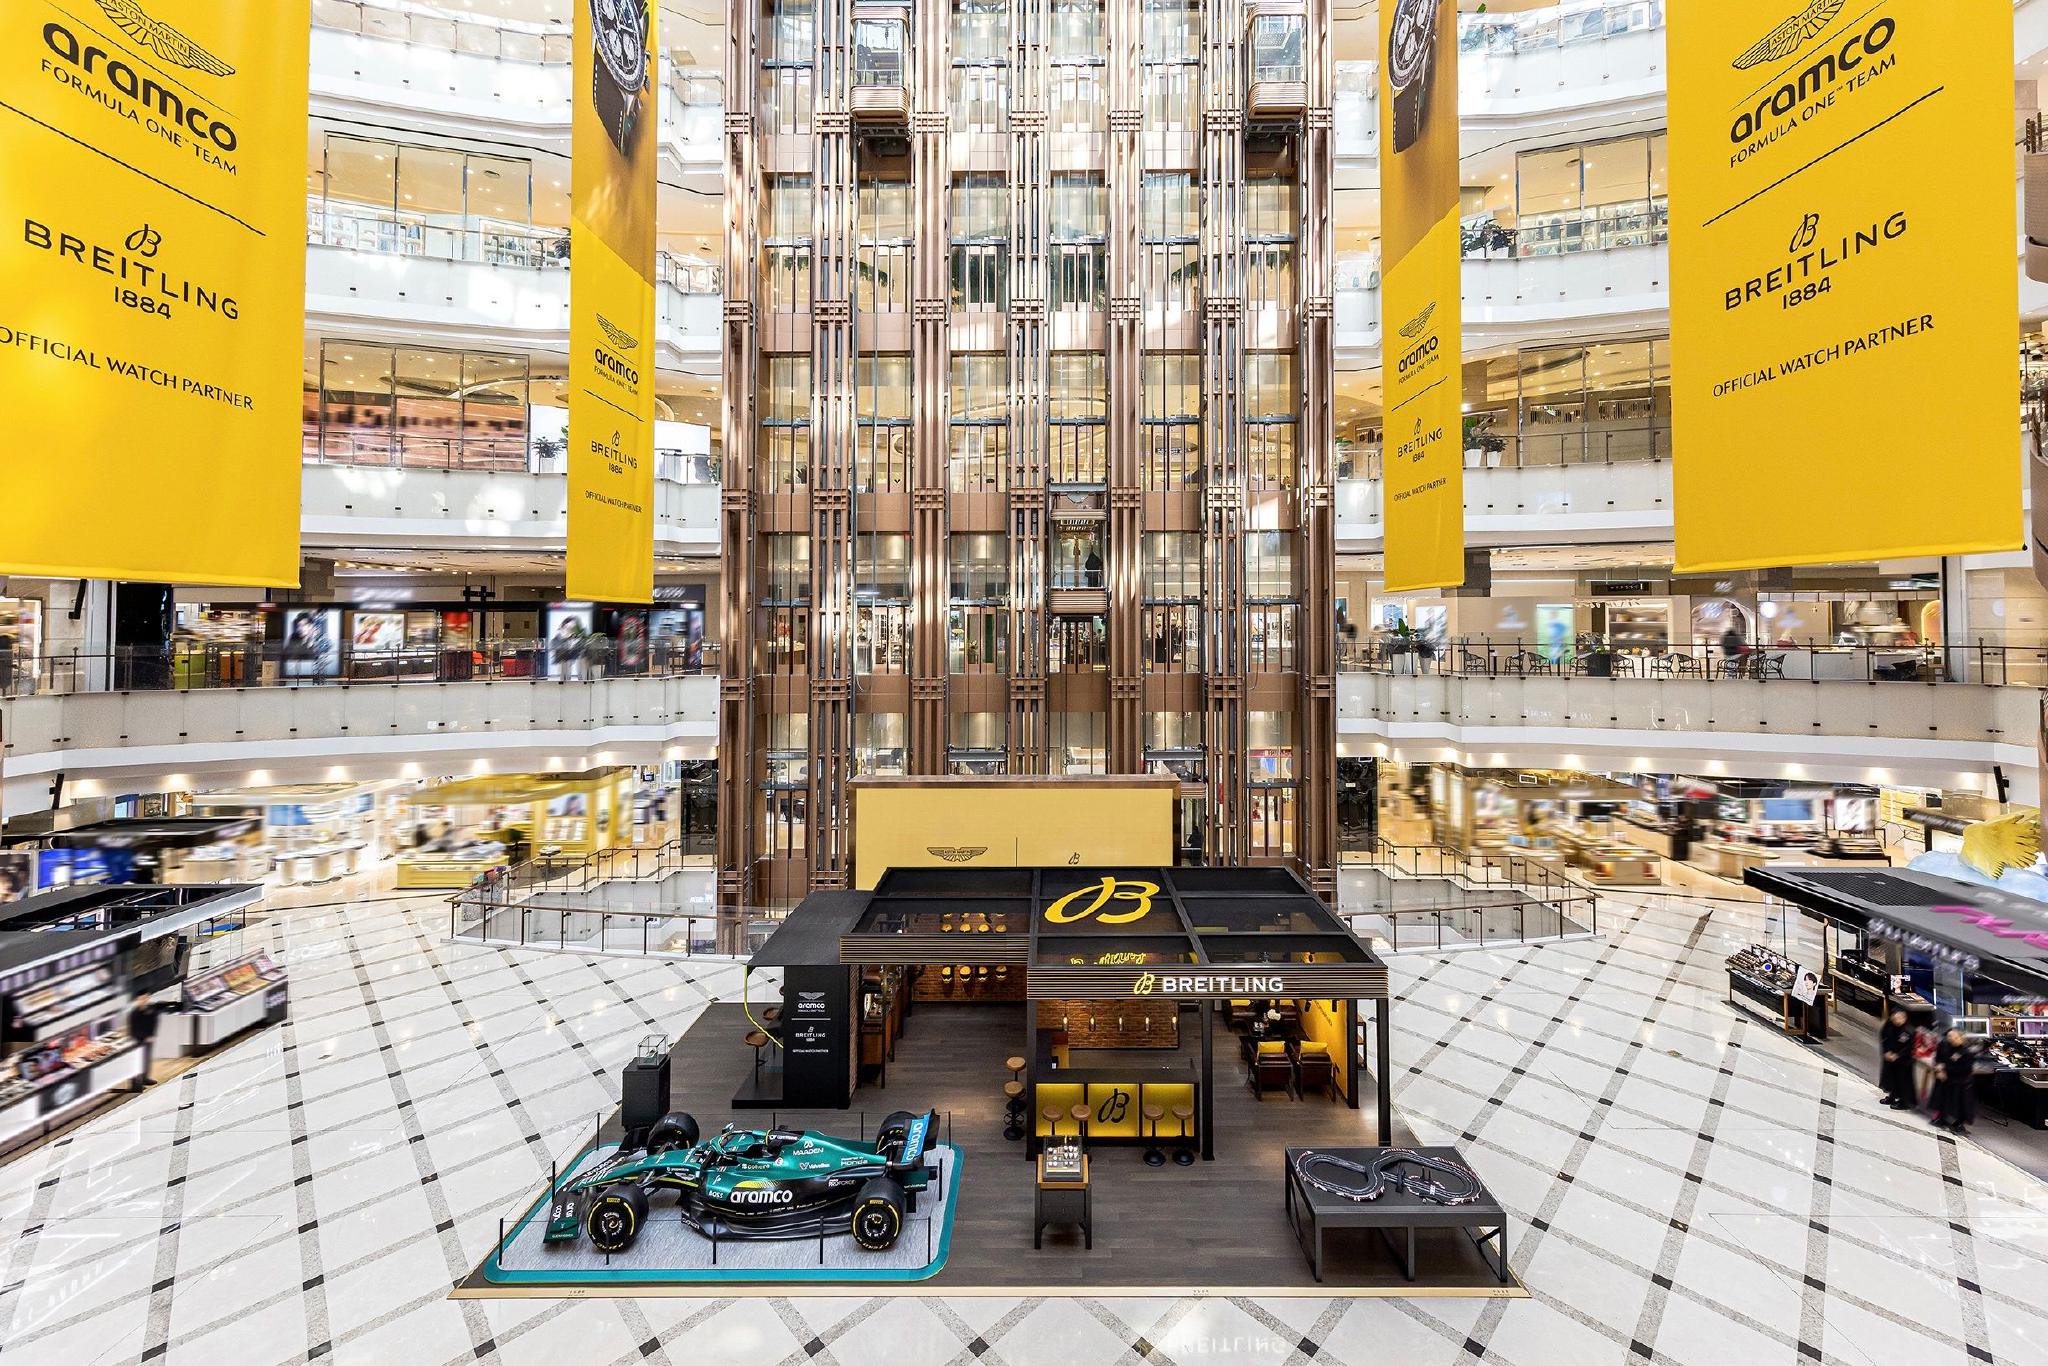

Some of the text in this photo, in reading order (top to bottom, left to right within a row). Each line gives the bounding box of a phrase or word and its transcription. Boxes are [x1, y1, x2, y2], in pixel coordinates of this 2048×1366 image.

[149, 23, 188, 54] MARTIN
[1770, 21, 1800, 46] ASTON
[43, 22, 238, 152] aramco
[1730, 17, 1896, 144] aramco
[41, 58, 140, 126] FORMULA
[193, 143, 238, 176] TEAM
[1730, 118, 1798, 168] FORMULA
[1846, 54, 1897, 93] TEAM
[24, 218, 239, 320] BREITLING
[1725, 211, 1907, 311] BREITLING
[114, 286, 172, 320] 1884
[1782, 276, 1832, 310] 1884
[0, 326, 254, 411] OFFICIAL WATCH PARTNER
[594, 348, 639, 385] aramco
[1398, 335, 1439, 373] aramco
[1713, 313, 1935, 398] OFFICIAL WATCH PARTNER
[591, 440, 638, 469] BREITLING
[1397, 427, 1443, 458] BREITLING
[1162, 977, 1284, 992] BREITLING
[906, 1122, 924, 1161] aramco
[730, 1189, 793, 1204] aramco
